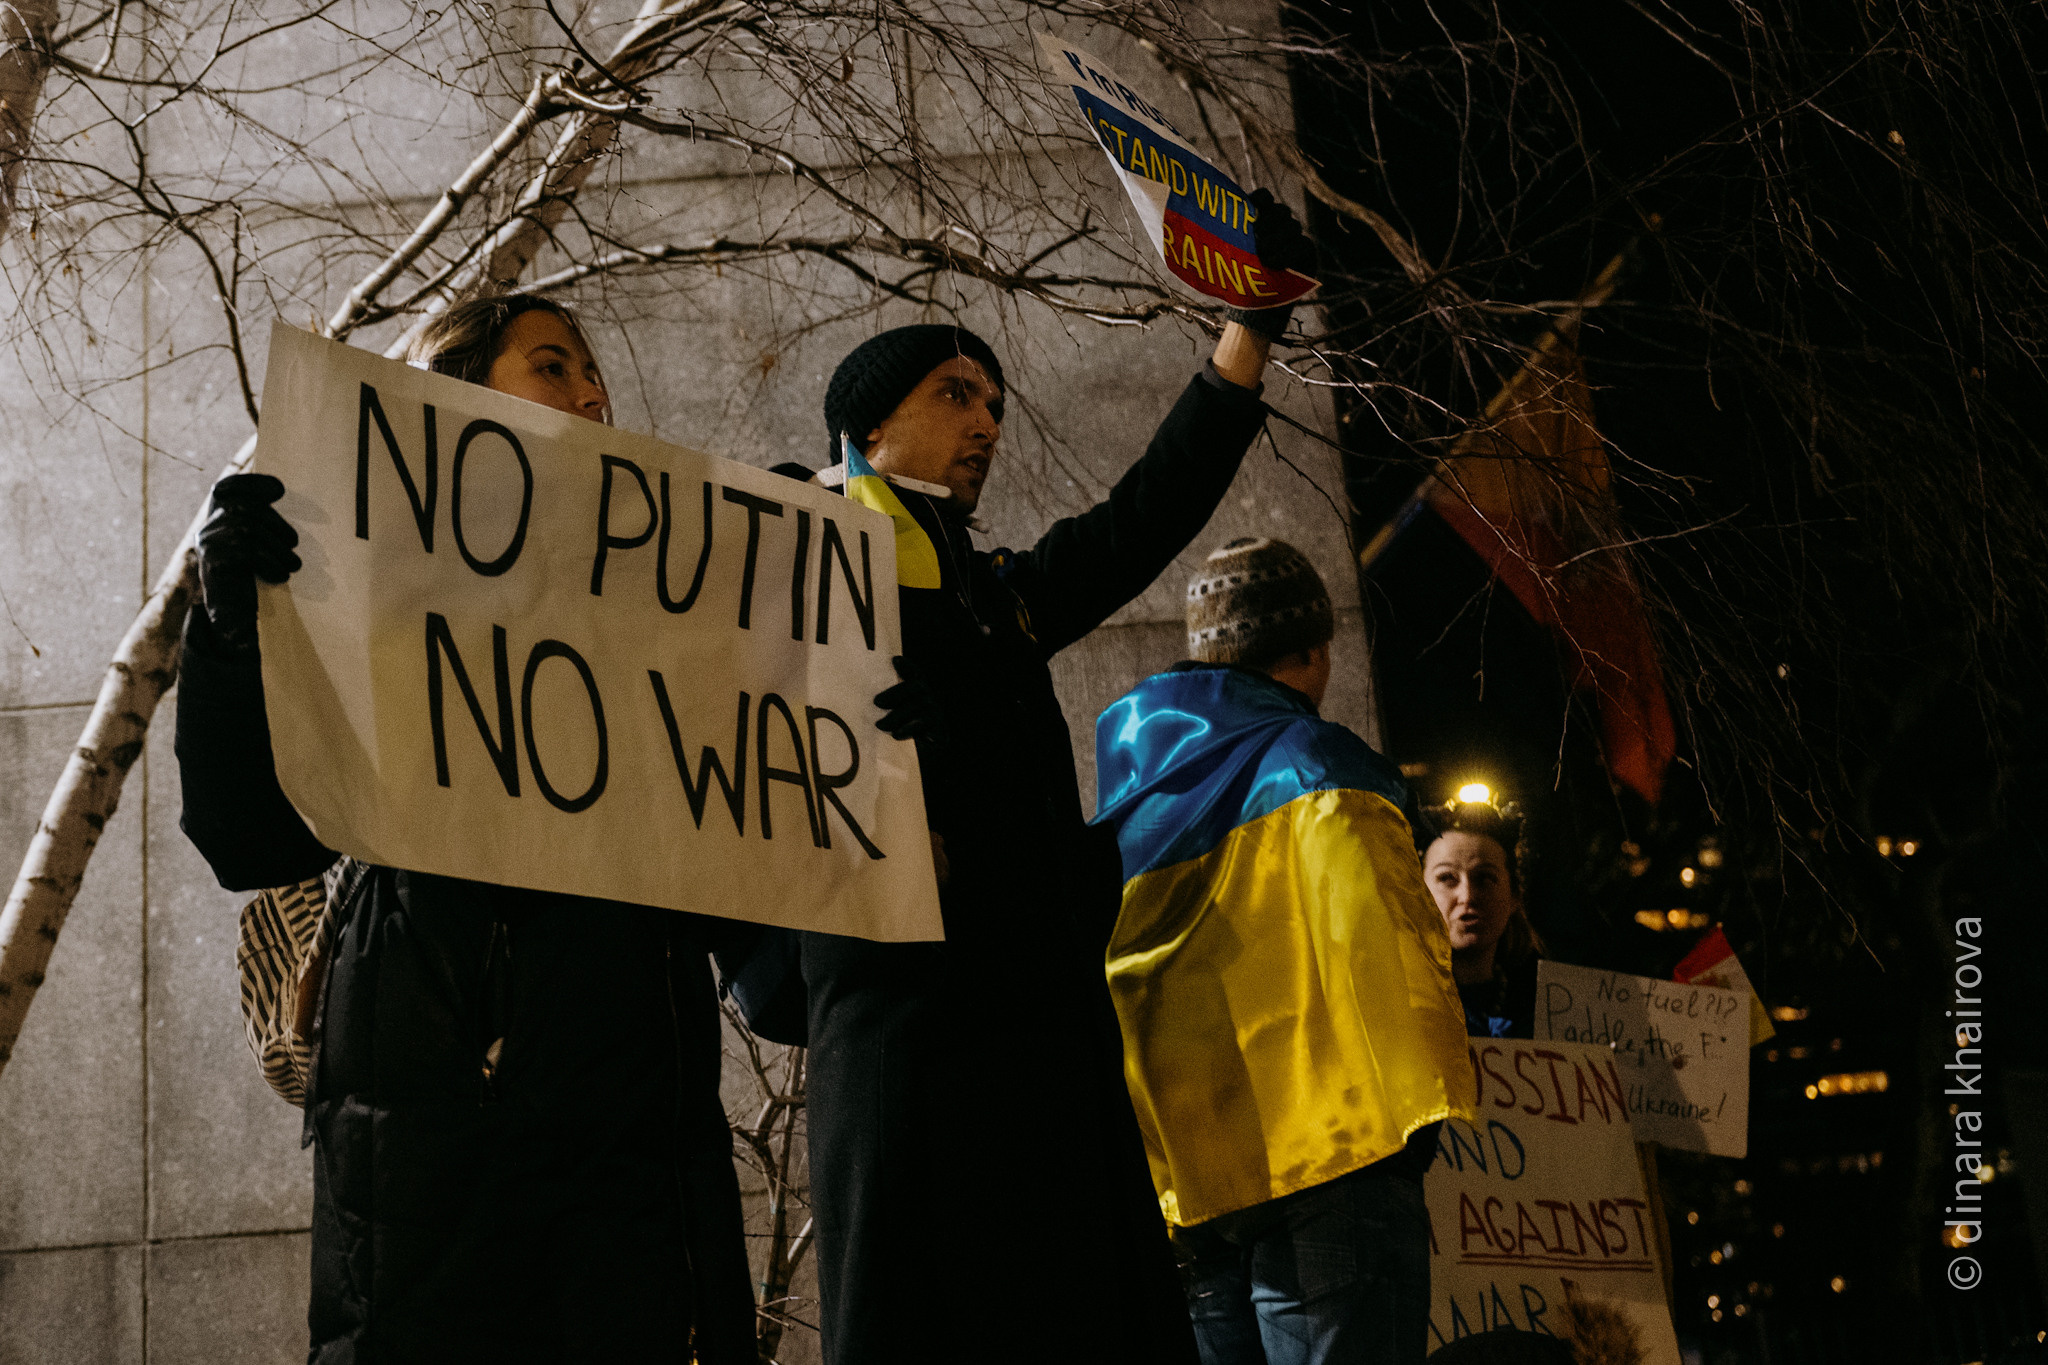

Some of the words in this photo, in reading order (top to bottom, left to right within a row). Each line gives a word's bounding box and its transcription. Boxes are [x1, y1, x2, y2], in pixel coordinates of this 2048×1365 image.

[1099, 117, 1189, 197] STAND
[354, 381, 535, 578] NO
[589, 452, 877, 651] PUTIN
[424, 611, 609, 814] NO
[646, 668, 887, 860] WAR
[1598, 973, 1631, 1003] No
[1458, 1192, 1647, 1258] AGAINST
